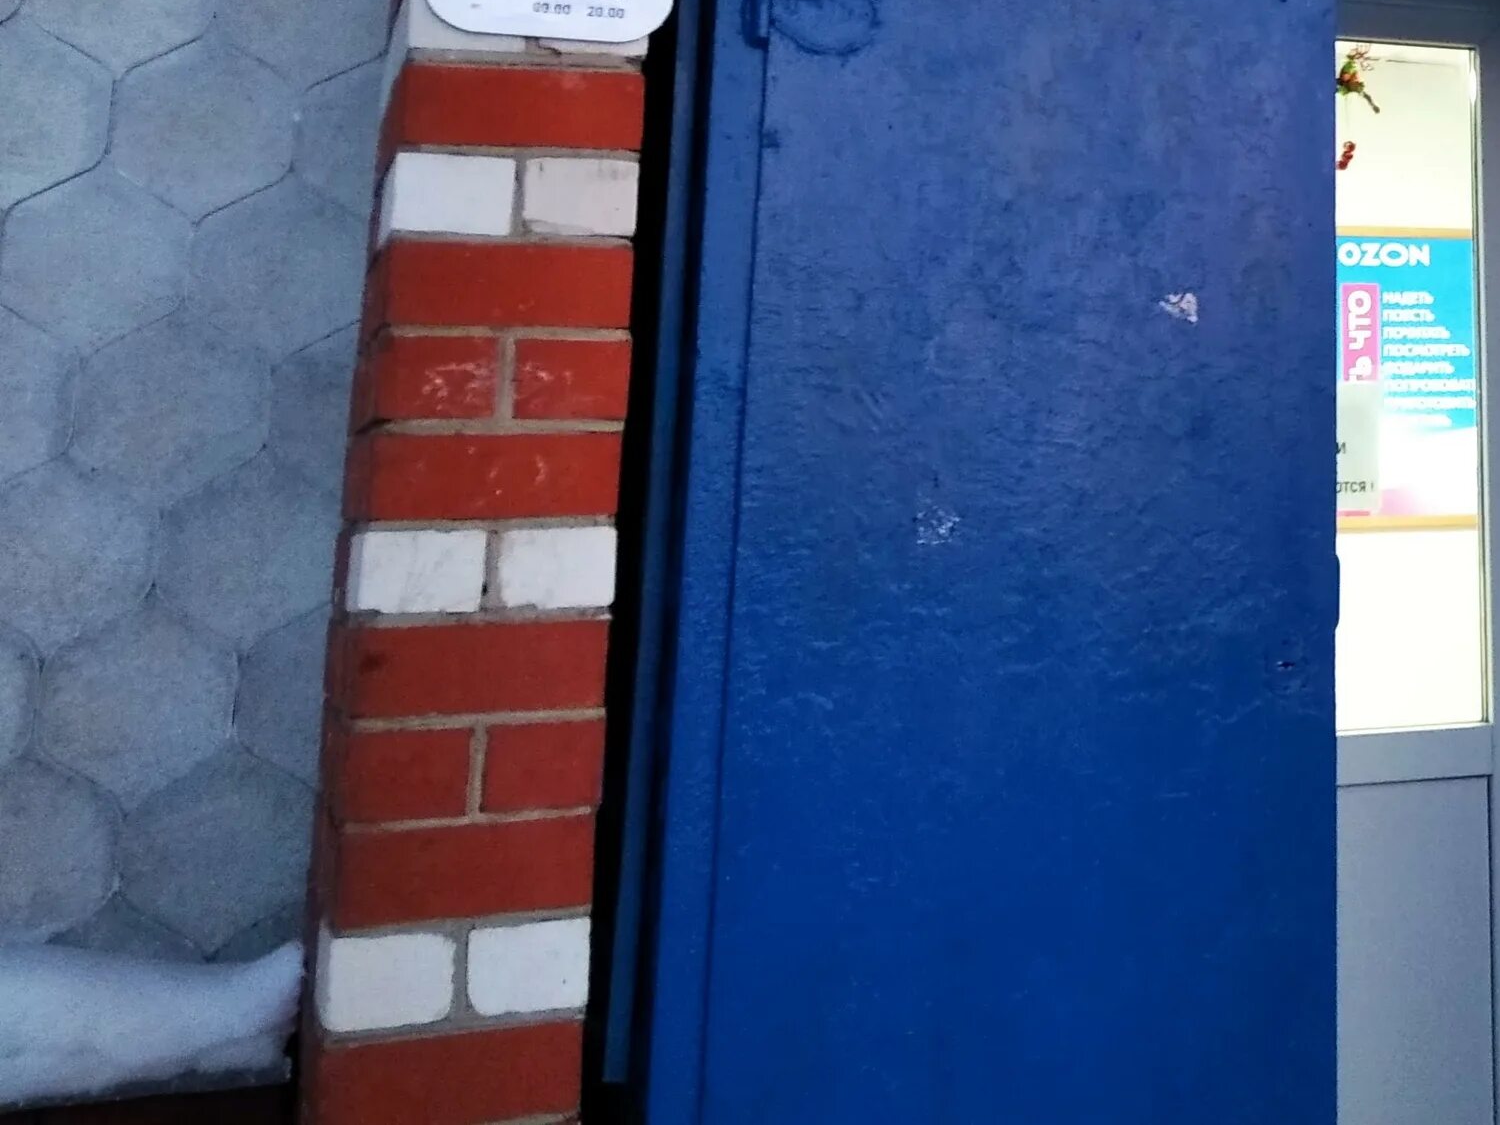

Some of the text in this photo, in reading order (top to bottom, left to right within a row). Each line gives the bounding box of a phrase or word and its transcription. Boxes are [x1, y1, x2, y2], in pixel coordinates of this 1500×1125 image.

[586, 5, 625, 19] 20.00
[1337, 241, 1431, 268] OZON
[1347, 290, 1372, 351] ЧТО
